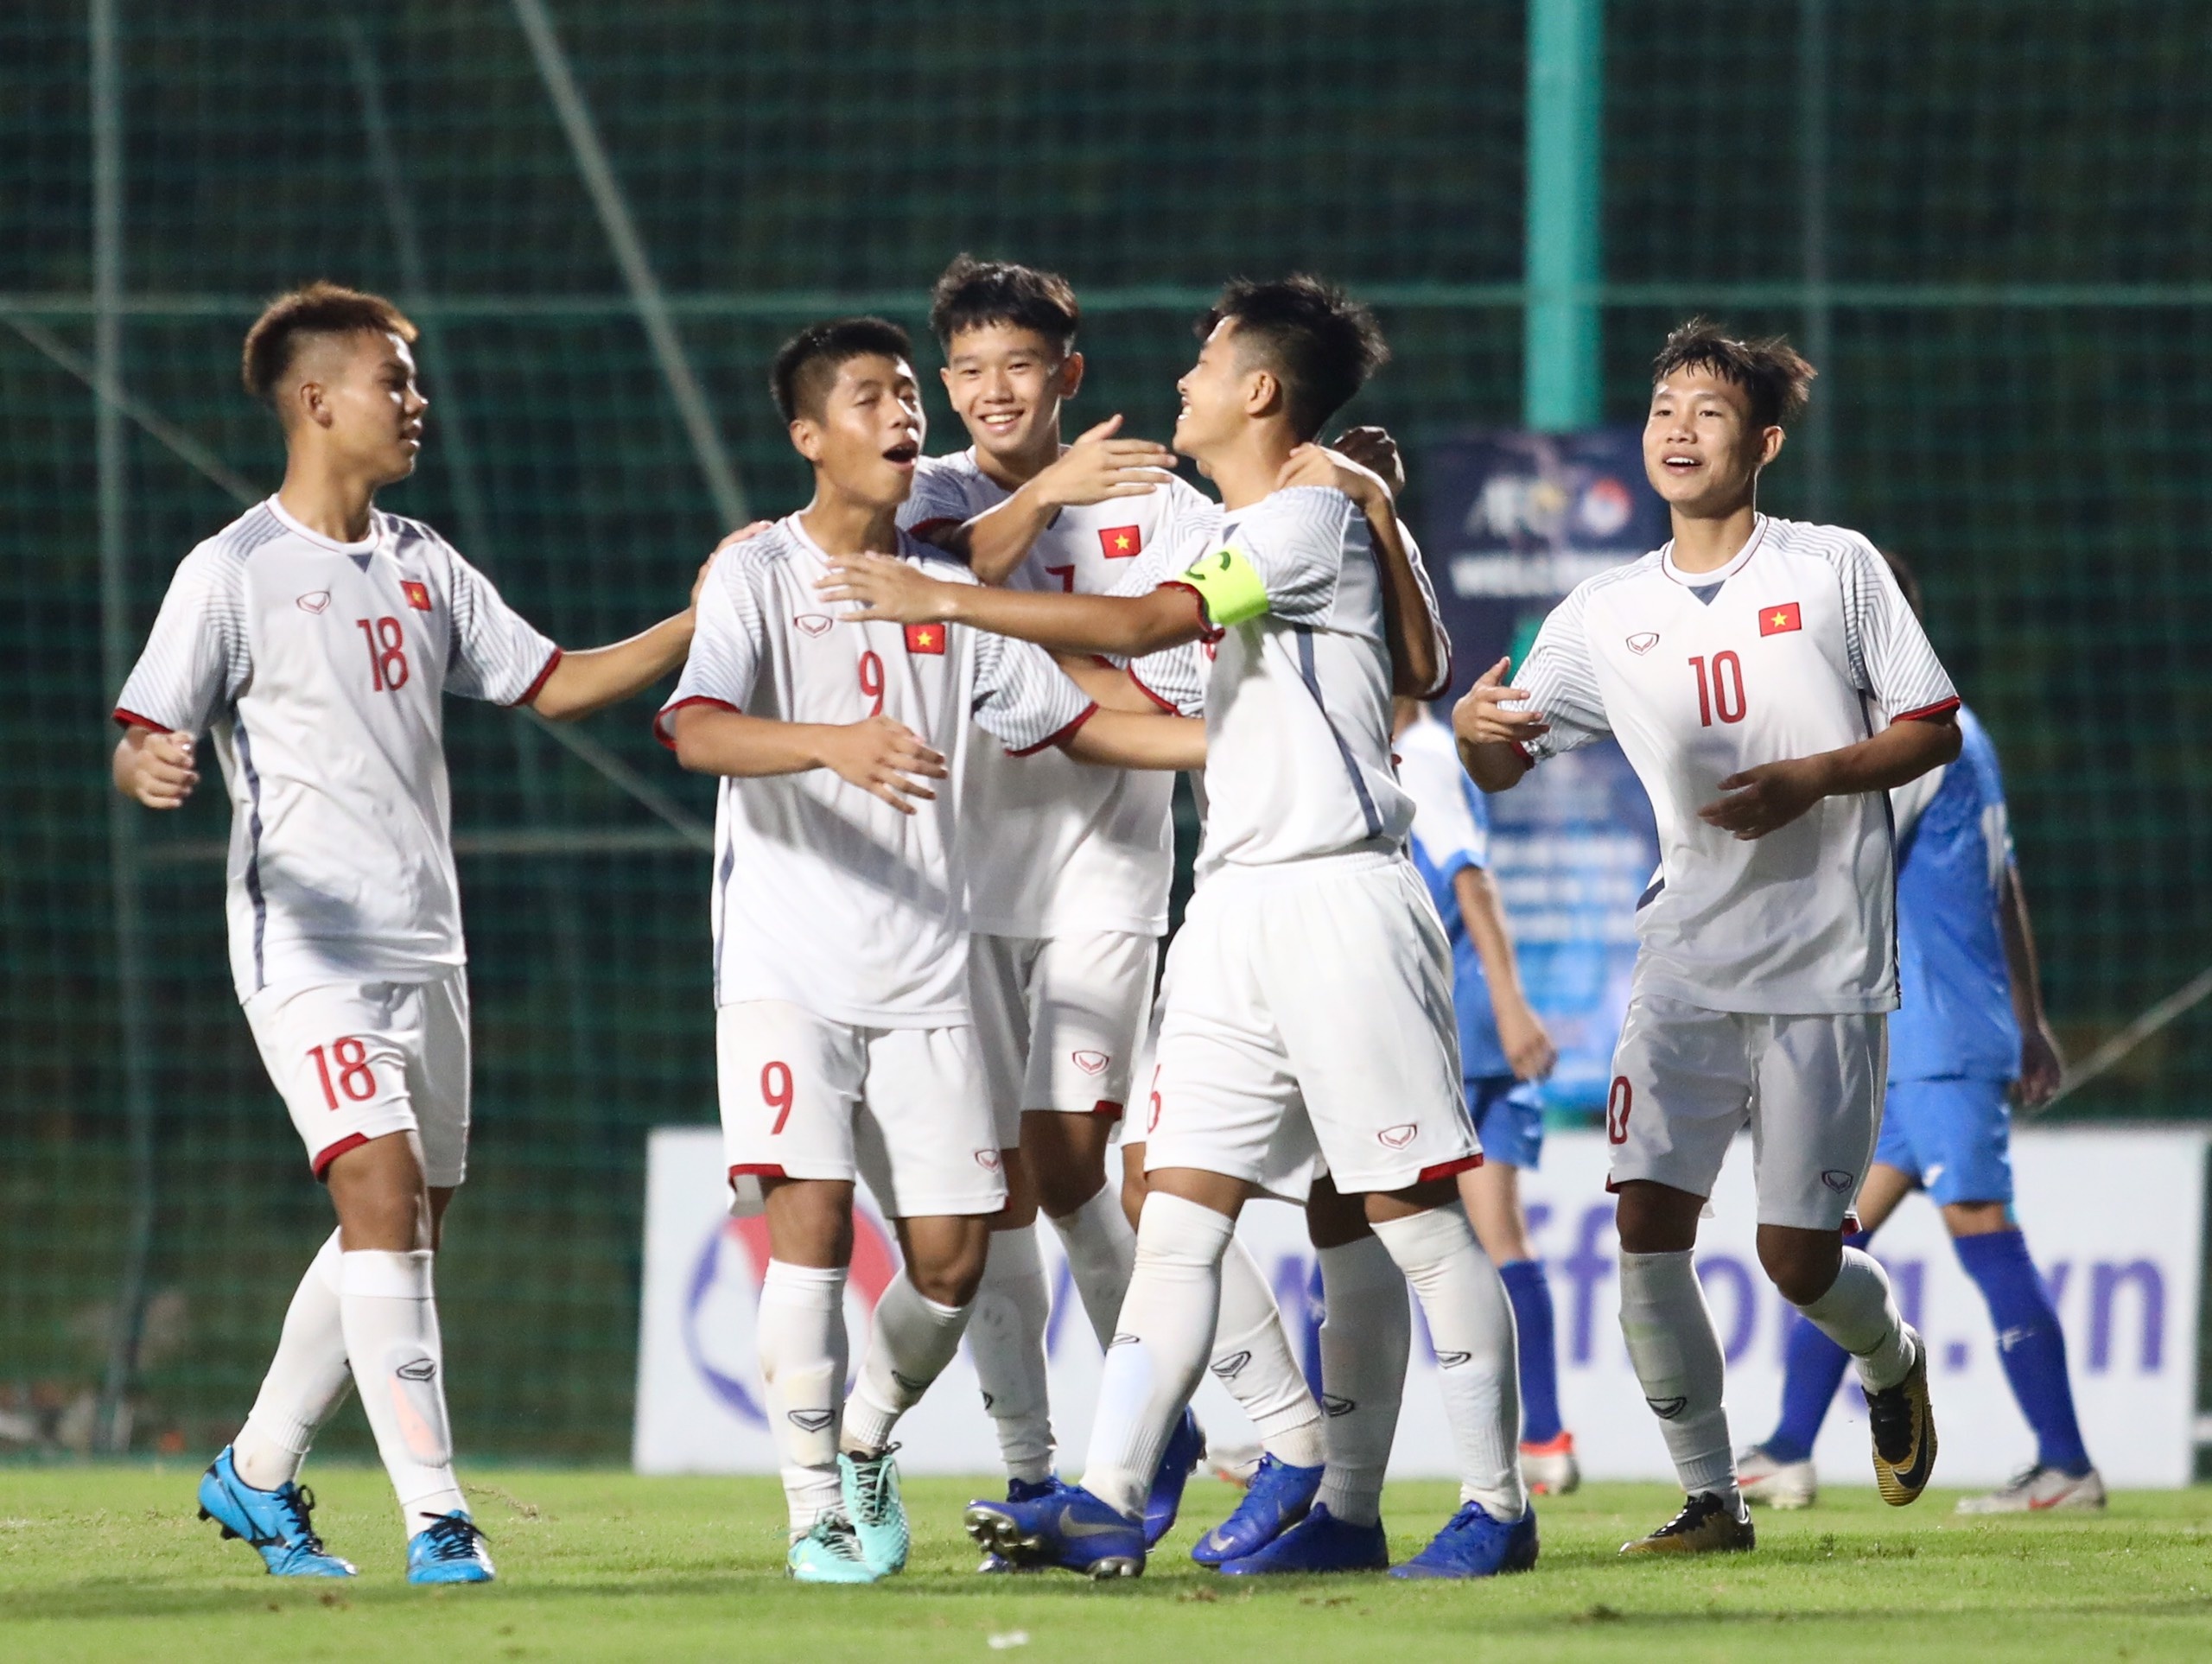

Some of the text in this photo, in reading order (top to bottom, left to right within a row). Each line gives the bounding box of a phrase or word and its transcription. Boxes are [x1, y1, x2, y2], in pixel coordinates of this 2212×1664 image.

[357, 616, 410, 692] 18
[858, 650, 885, 717] 9
[1688, 650, 1747, 727] 10
[305, 1036, 378, 1111] 18
[760, 1060, 795, 1136] 9
